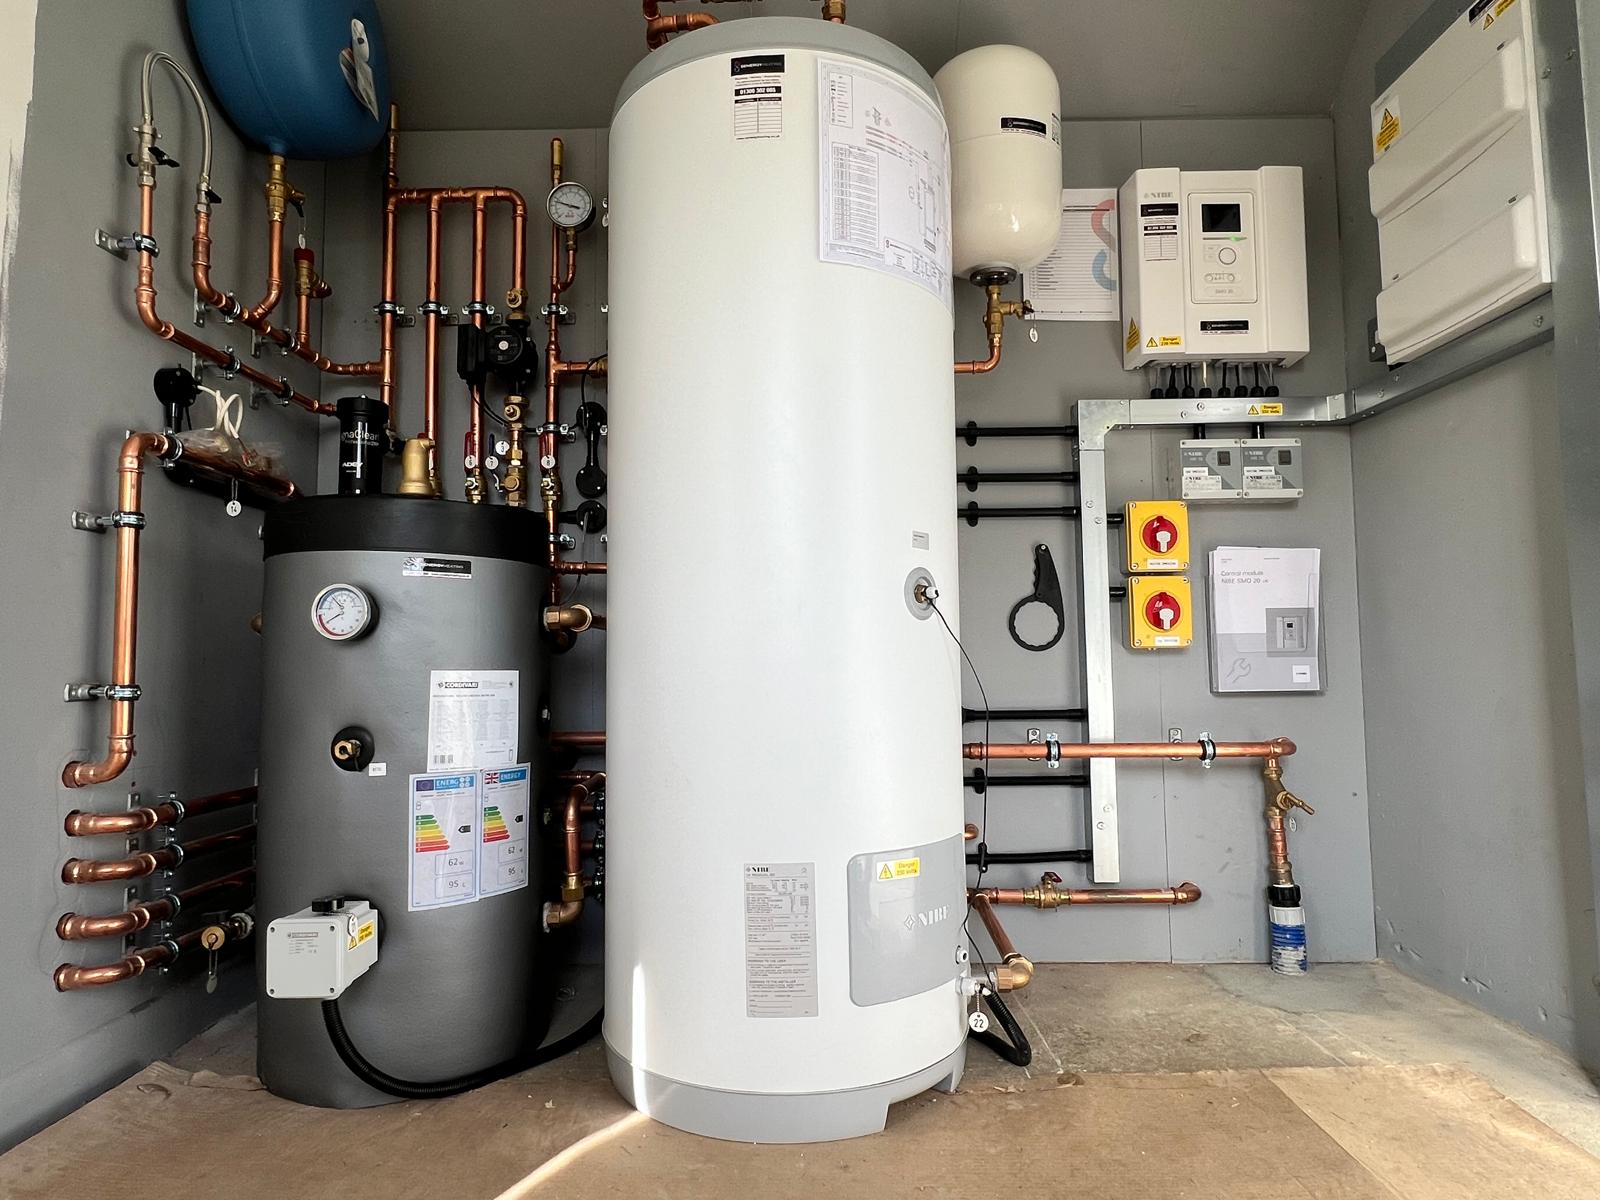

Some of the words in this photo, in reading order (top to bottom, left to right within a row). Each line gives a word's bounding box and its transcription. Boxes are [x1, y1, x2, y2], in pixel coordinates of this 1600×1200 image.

[500, 772, 522, 781] ENERGY
[436, 778, 459, 787] ENERG
[507, 846, 515, 854] 62
[448, 858, 458, 867] 62
[507, 867, 516, 876] 95
[448, 880, 459, 889] 95
[973, 1018, 984, 1029] 22
